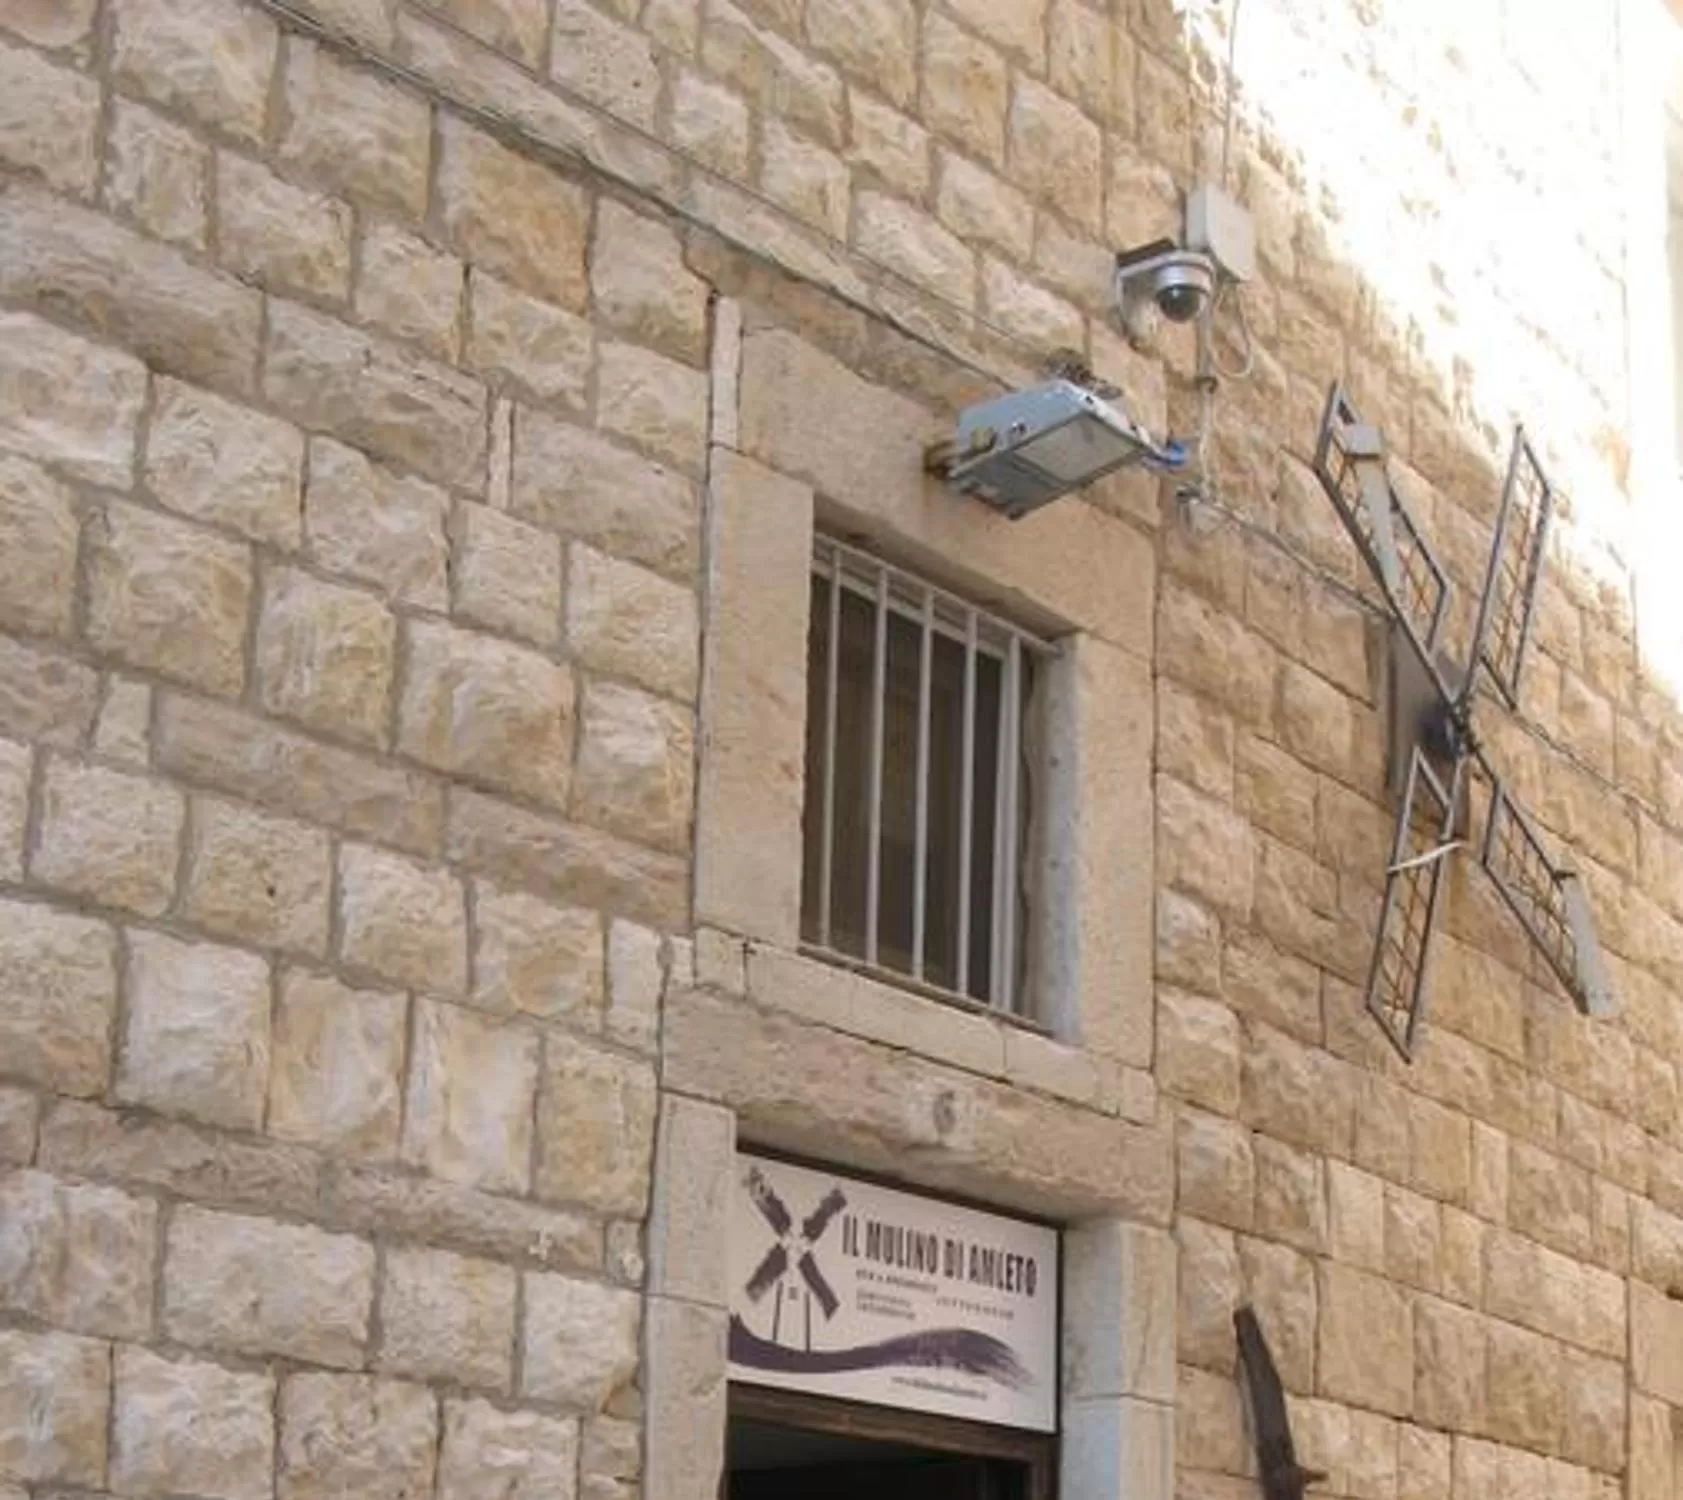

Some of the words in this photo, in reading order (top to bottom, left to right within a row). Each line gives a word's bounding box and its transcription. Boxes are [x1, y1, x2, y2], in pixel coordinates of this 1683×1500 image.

[842, 1214, 859, 1258] IL
[866, 1220, 938, 1275] MULINO
[943, 1238, 965, 1281] DI
[968, 1243, 1037, 1297] AMLETO
